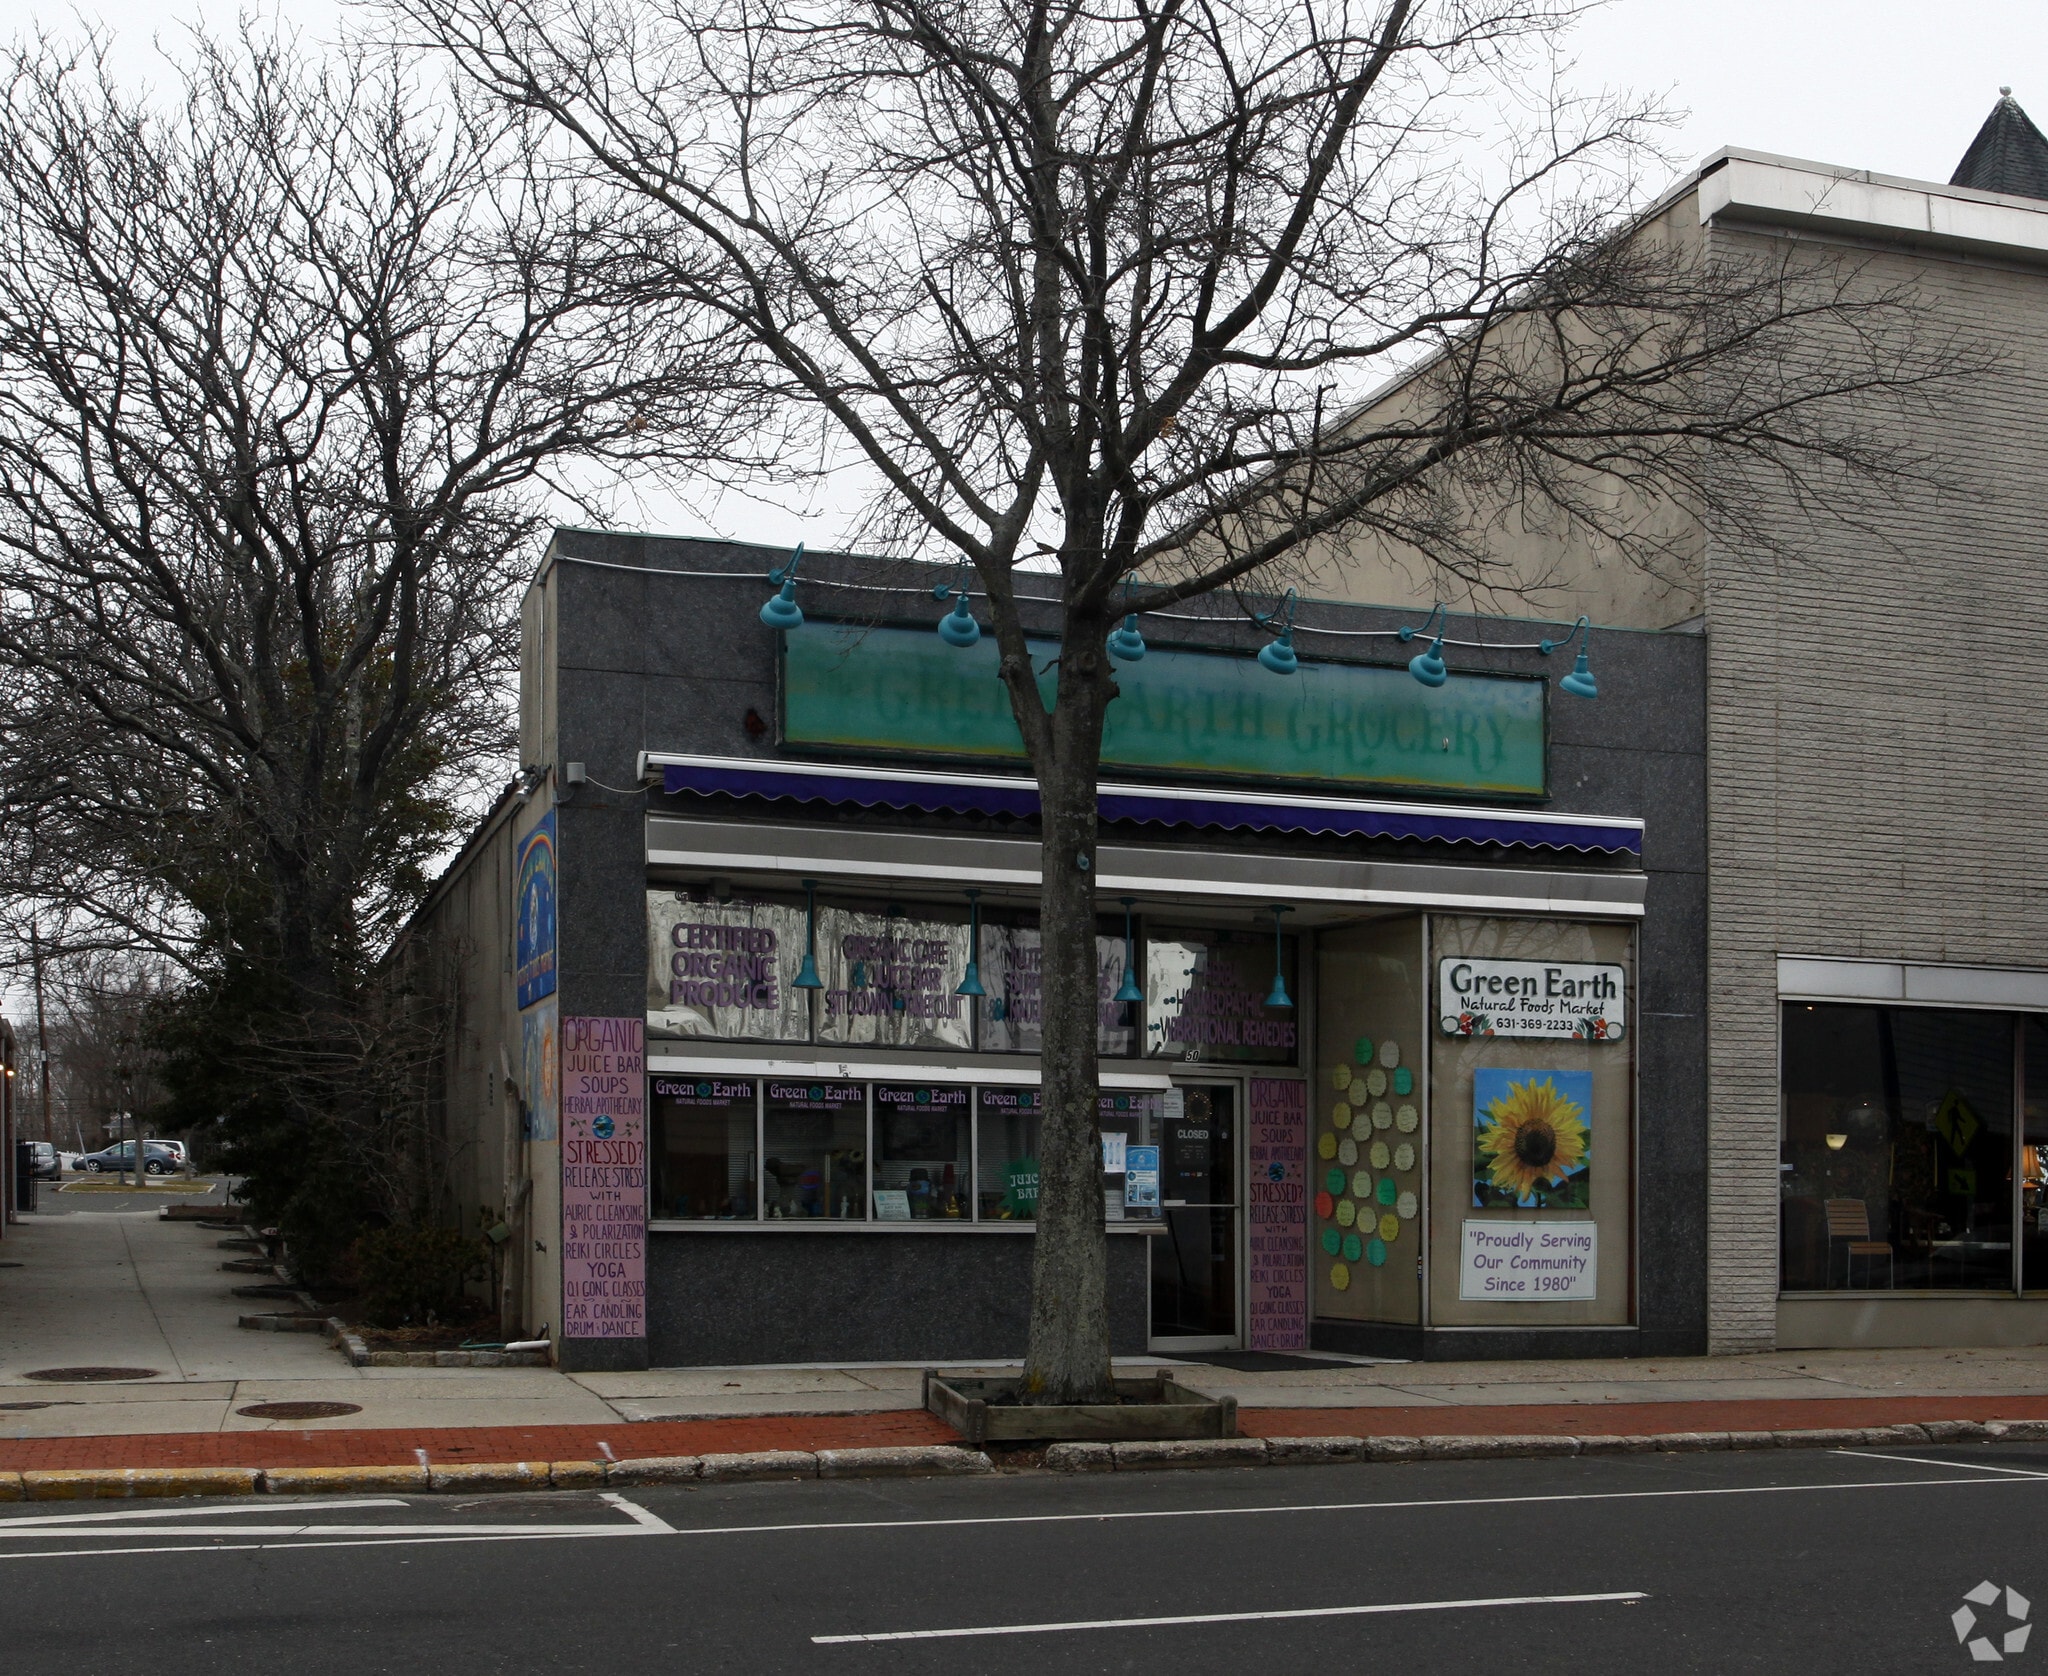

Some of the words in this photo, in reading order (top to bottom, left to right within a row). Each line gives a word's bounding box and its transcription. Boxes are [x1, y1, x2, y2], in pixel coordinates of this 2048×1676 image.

[1287, 694, 1512, 774] GROCERY
[672, 923, 777, 954] CERTIFIED
[843, 935, 911, 963] ORGANIC
[671, 951, 778, 983] ORGANIC
[869, 964, 911, 990] JUICE
[911, 966, 942, 991] BAR
[1450, 963, 1538, 996] Green
[1544, 968, 1617, 1000] Earth
[670, 979, 780, 1010] PRODUCE
[1177, 988, 1265, 1018] HOMEOPATHIC
[1460, 996, 1516, 1012] Natural
[1520, 997, 1555, 1014] Foods
[1560, 999, 1605, 1015] Market
[1160, 1015, 1240, 1044] VIBRATIONAL
[1243, 1021, 1296, 1048] REMEDIES
[1496, 1018, 1574, 1031] 631-369-2233
[565, 1018, 643, 1053] ORGANIC
[567, 1054, 612, 1073] JUICE
[617, 1055, 643, 1074] BAR
[1185, 1050, 1200, 1062] 50
[580, 1075, 629, 1095] SOUPS
[655, 1079, 695, 1096] Green
[712, 1081, 751, 1098] Earth
[770, 1083, 808, 1099] Green
[824, 1085, 862, 1101] Earth
[878, 1087, 915, 1103] Green
[930, 1088, 967, 1104] Earth
[983, 1090, 1017, 1106] Green
[1250, 1080, 1305, 1109] ORGANIC
[564, 1096, 595, 1114] HERBAL
[594, 1097, 643, 1115] APOTHECARY
[825, 1102, 843, 1110] MARKET
[1250, 1111, 1281, 1125] JUICE
[1283, 1112, 1303, 1126] BAR
[1177, 1128, 1209, 1140] CLOSED
[1260, 1128, 1294, 1143] SOUPS
[567, 1140, 644, 1165] STRESSED?
[565, 1167, 611, 1188] RELEASE
[612, 1167, 644, 1188] STRESS
[1010, 1172, 1040, 1187] JUIC
[589, 1191, 621, 1201] WITH
[1250, 1183, 1304, 1203] STRESSED?
[565, 1204, 593, 1221] AURIC
[596, 1204, 644, 1222] CLEANSING
[1250, 1205, 1280, 1224] RELEASE
[1281, 1205, 1305, 1224] STRESS
[583, 1223, 644, 1240] POLARIZATION
[1265, 1225, 1288, 1234] WITH
[565, 1242, 590, 1260] REIKI
[594, 1242, 641, 1260] CIRCLES
[1268, 1236, 1304, 1251] CLEANSING
[1540, 1233, 1592, 1251] Serving
[587, 1262, 627, 1278] YOGA
[1473, 1254, 1504, 1270] Our
[1510, 1255, 1587, 1273] Community
[1250, 1269, 1269, 1283] REIKI
[1273, 1269, 1304, 1283] CIRCLES
[1484, 1276, 1526, 1291] Since
[567, 1281, 579, 1297] QI
[582, 1280, 609, 1297] GONG
[612, 1280, 645, 1297] CLASSES
[1266, 1286, 1292, 1298] YOGA
[566, 1303, 588, 1319] EAR
[593, 1303, 642, 1319] CANDLING
[1278, 1301, 1304, 1315] CLASSES
[566, 1321, 594, 1336] DRUM
[602, 1321, 639, 1336] DANCE
[1250, 1318, 1266, 1331] EAR
[1268, 1317, 1304, 1331] CANDLING
[1250, 1333, 1277, 1348] DANCE
[1280, 1334, 1304, 1348] DRUM
